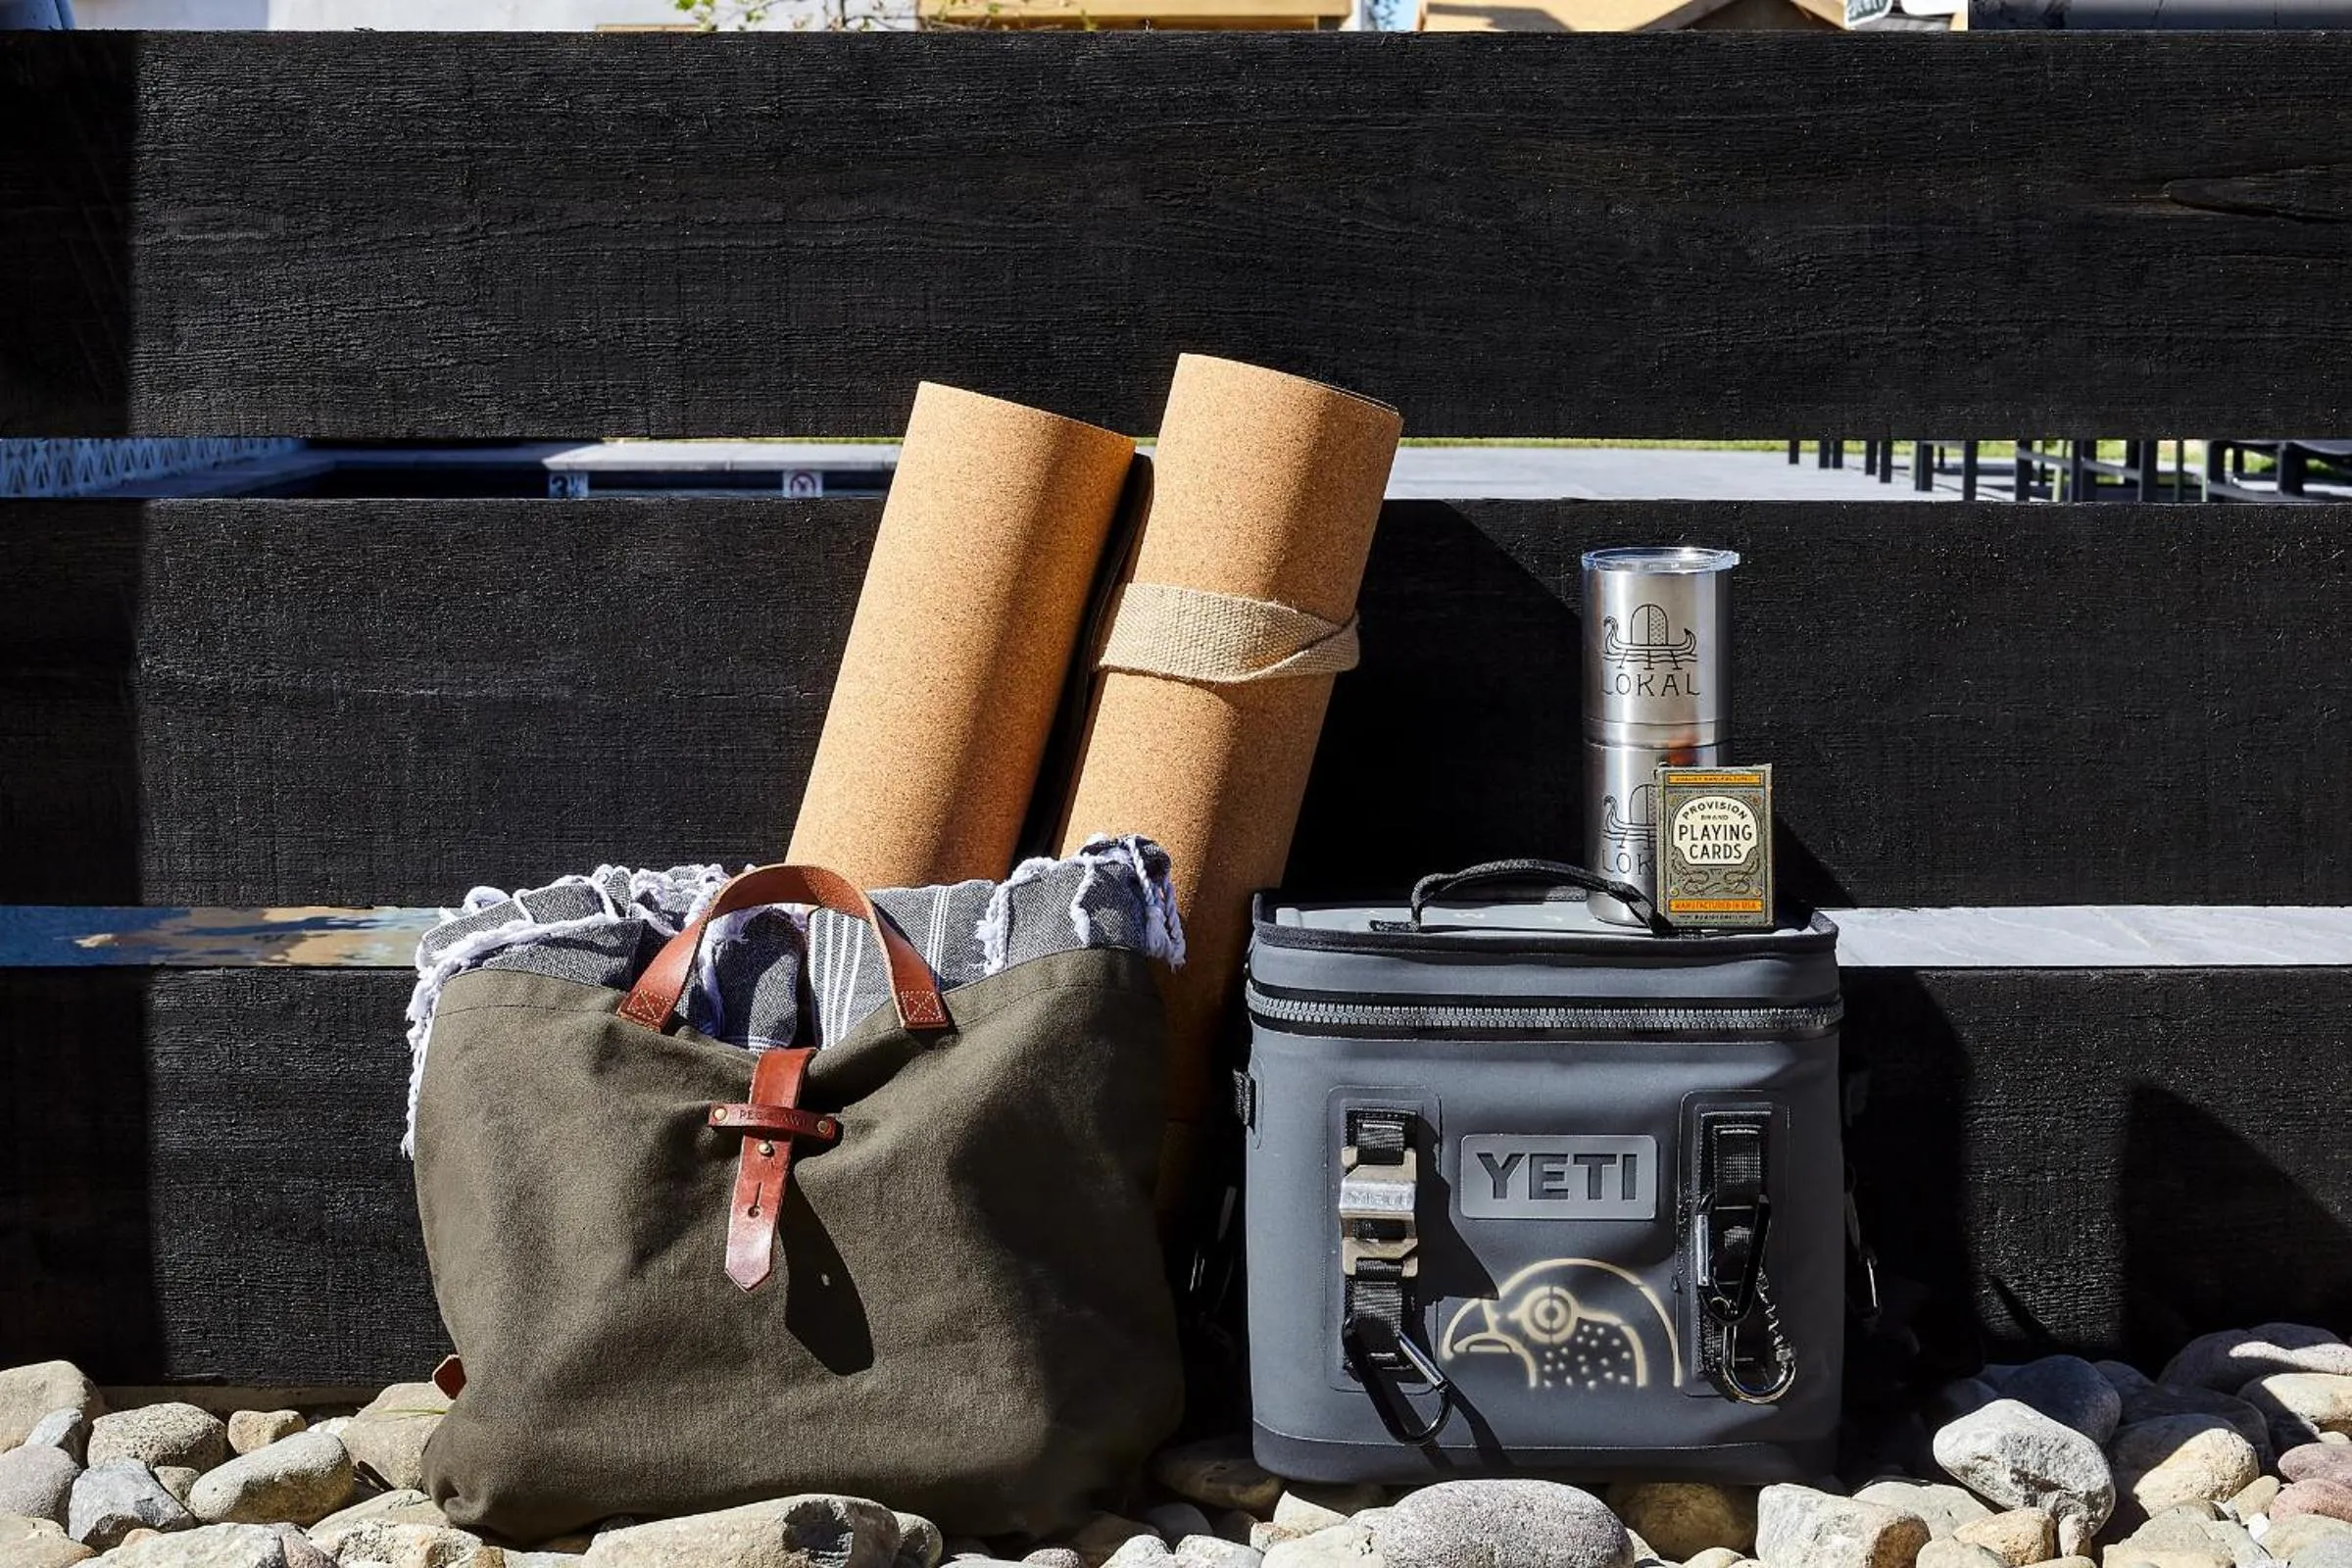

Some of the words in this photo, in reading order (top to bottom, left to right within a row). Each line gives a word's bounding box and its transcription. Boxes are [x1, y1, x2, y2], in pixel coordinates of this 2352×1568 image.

[1600, 671, 1701, 697] LOKAL
[1682, 801, 1747, 820] PROVISION
[1678, 824, 1752, 841] PLAYING
[1601, 849, 1656, 875] LOK
[1690, 843, 1741, 859] CARDS
[1477, 1152, 1638, 1201] YETI
